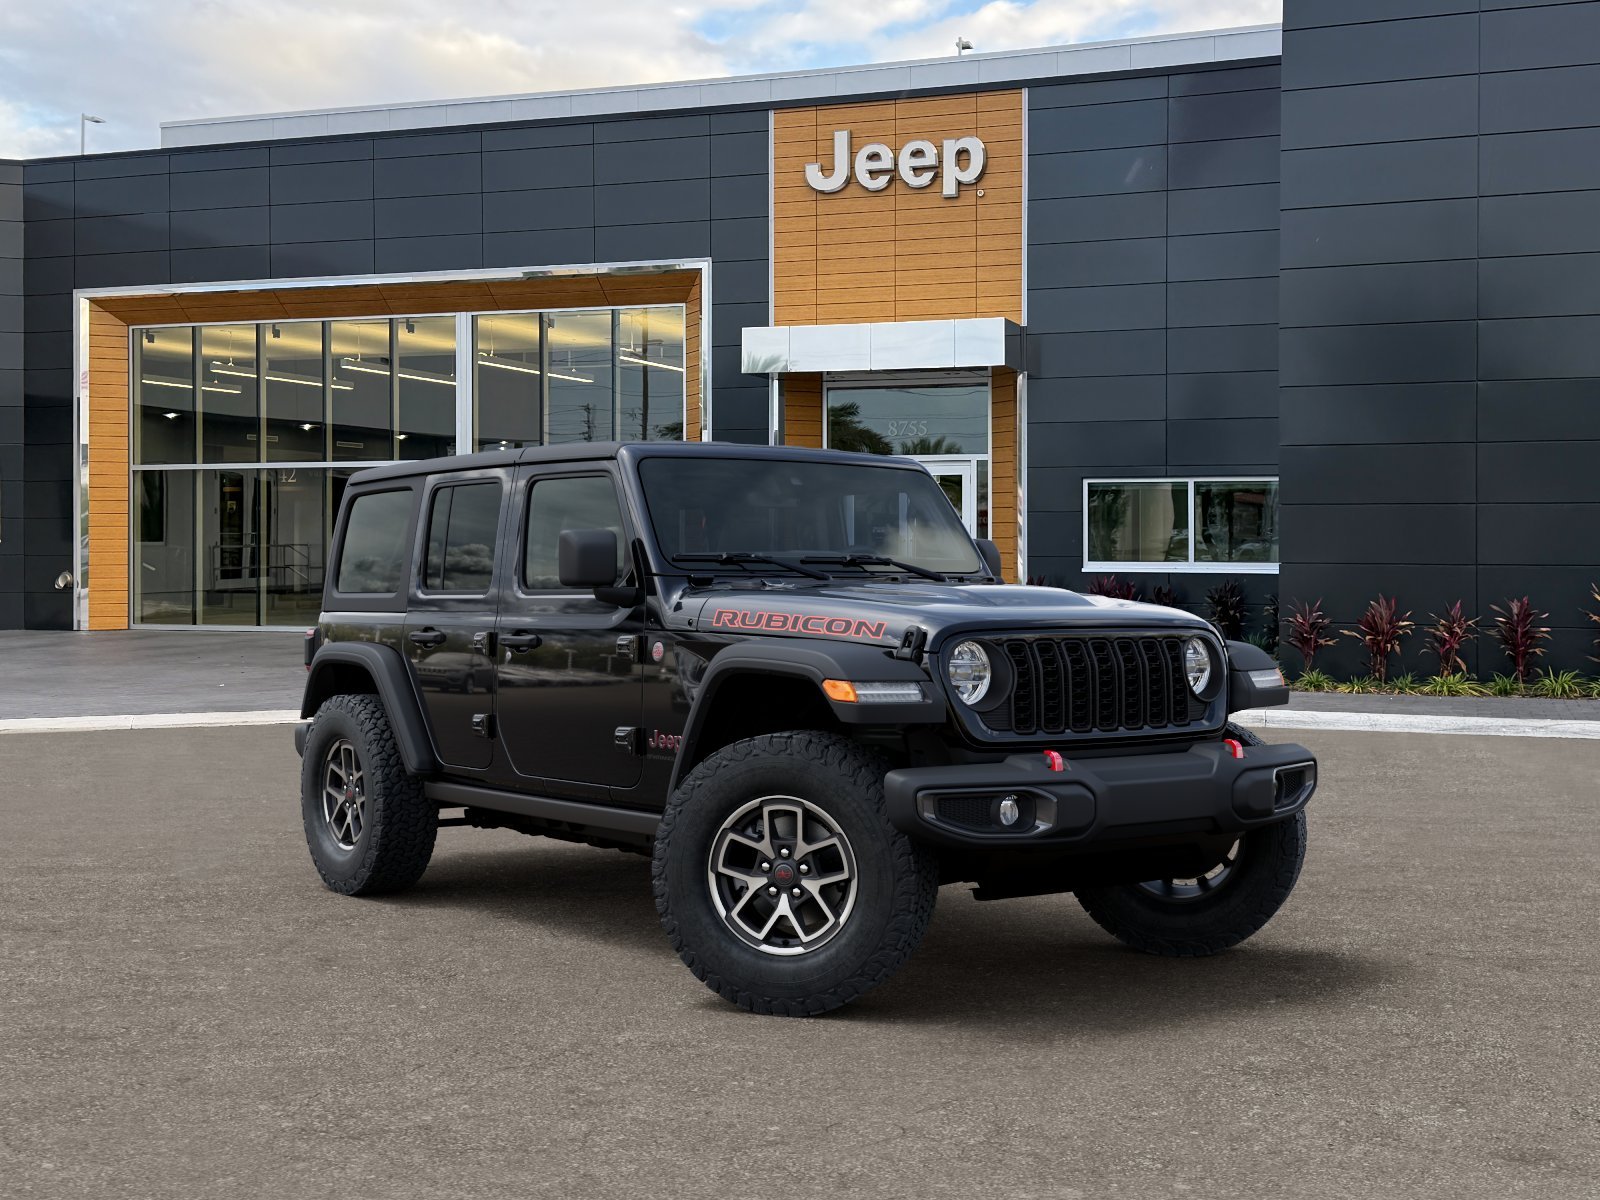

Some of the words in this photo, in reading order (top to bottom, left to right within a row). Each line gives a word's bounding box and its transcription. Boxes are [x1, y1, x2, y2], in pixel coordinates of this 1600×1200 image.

[804, 129, 987, 199] Jeep
[888, 420, 928, 437] 8755
[712, 608, 887, 640] RUBICON
